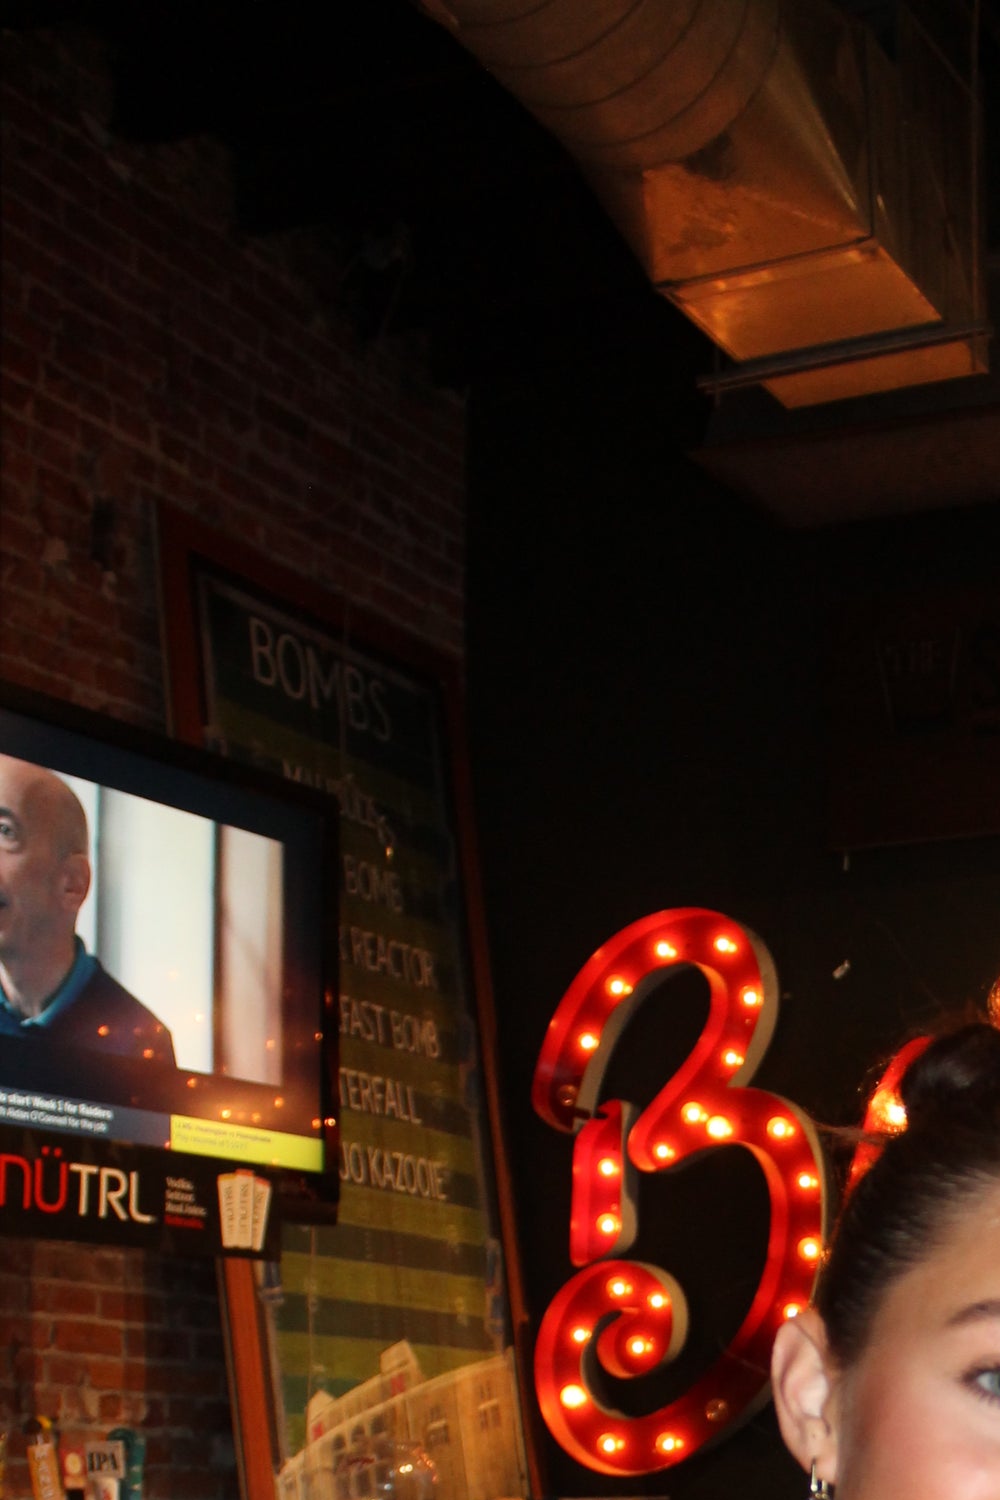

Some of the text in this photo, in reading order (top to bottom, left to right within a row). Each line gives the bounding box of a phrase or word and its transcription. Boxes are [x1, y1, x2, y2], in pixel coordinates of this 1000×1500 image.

[249, 616, 391, 742] BOMBS
[350, 926, 439, 990] REACTOR
[390, 1010, 440, 1059] BOMB
[367, 1145, 448, 1201] KAZOOIE
[88, 1452, 118, 1473] IPA
